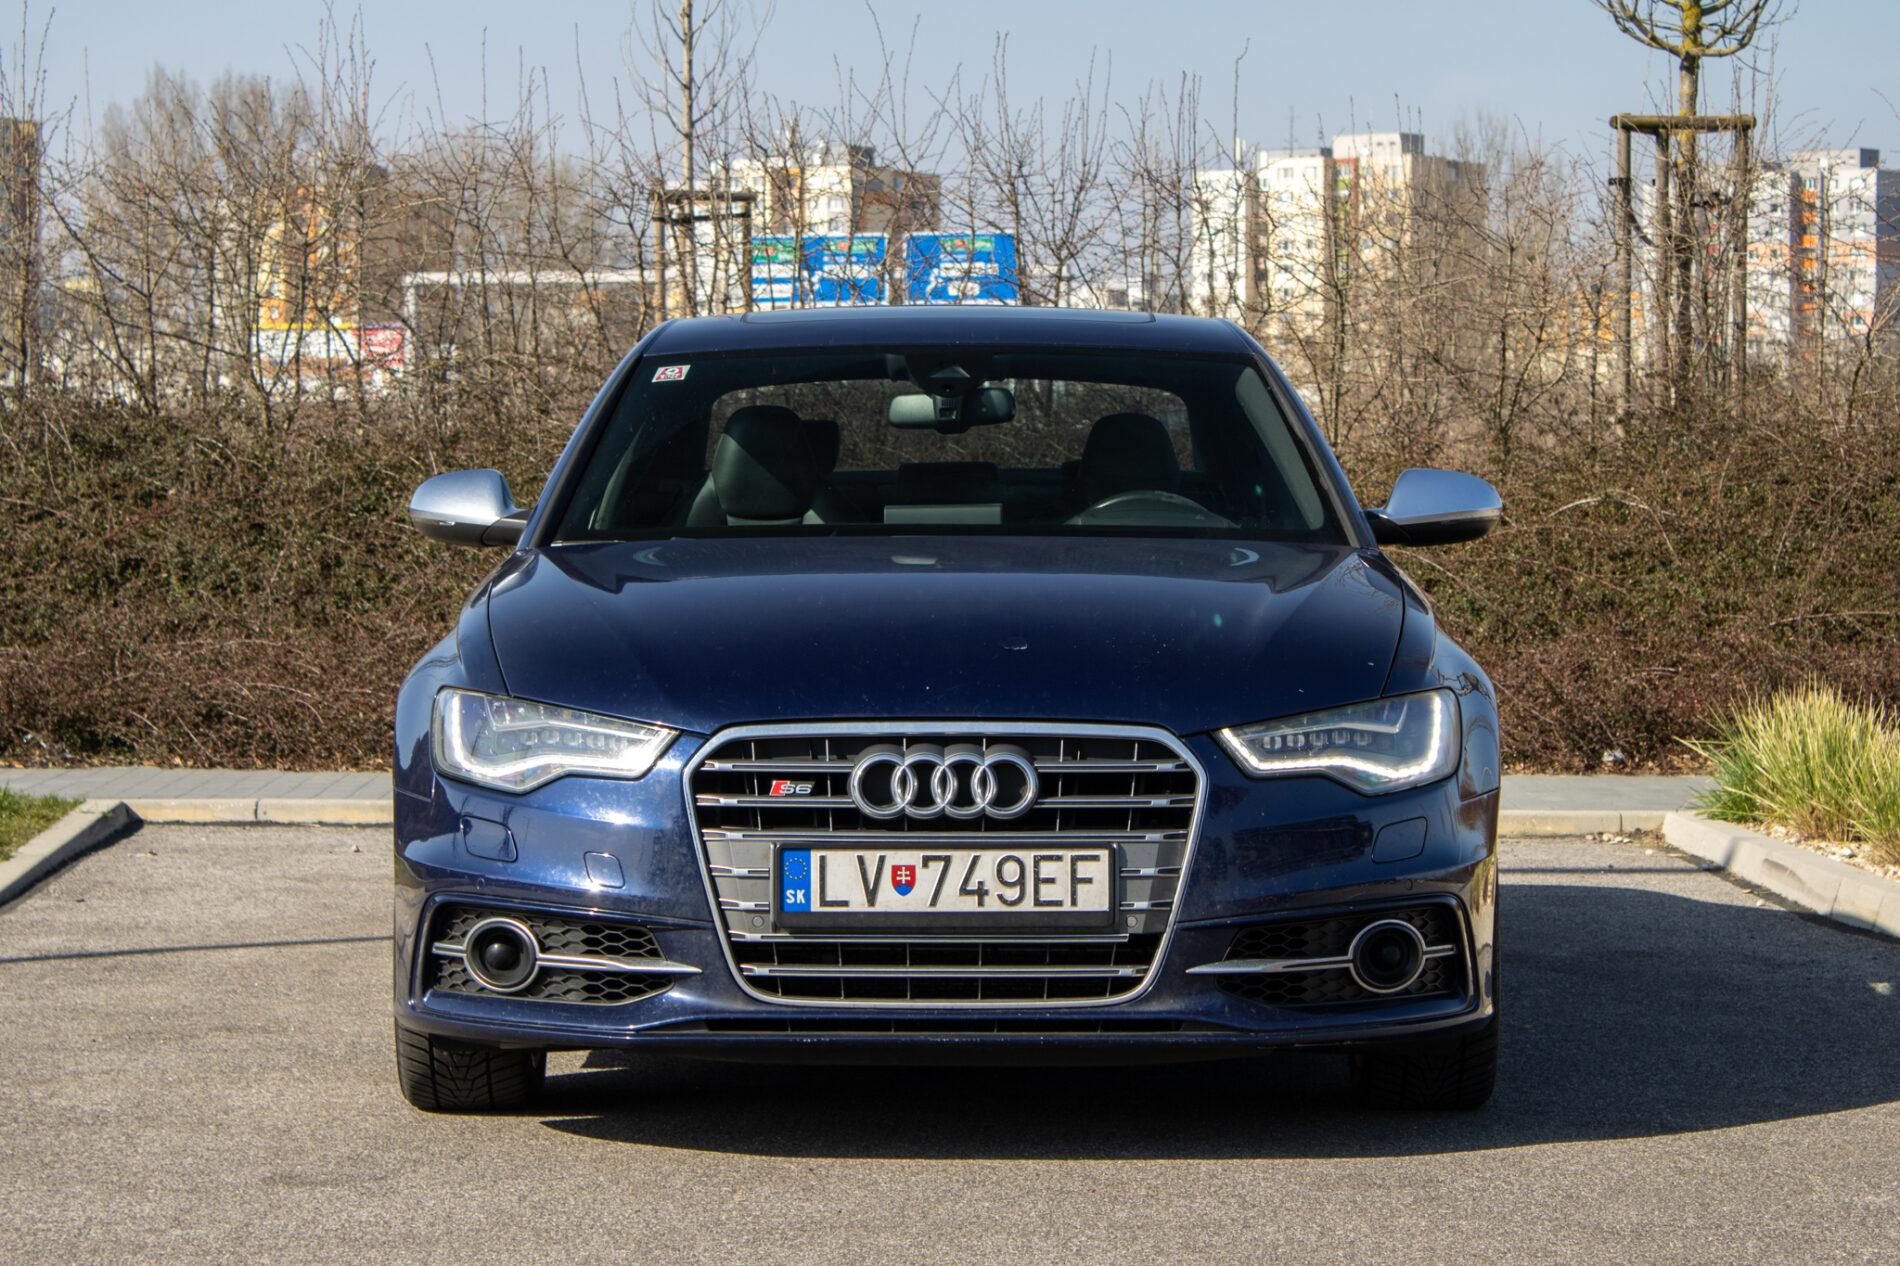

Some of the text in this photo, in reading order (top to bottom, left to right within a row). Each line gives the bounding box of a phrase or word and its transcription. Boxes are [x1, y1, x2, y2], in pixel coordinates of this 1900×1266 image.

[779, 783, 813, 795] S6
[818, 854, 1101, 908] LV 749EF
[785, 888, 806, 904] SK
